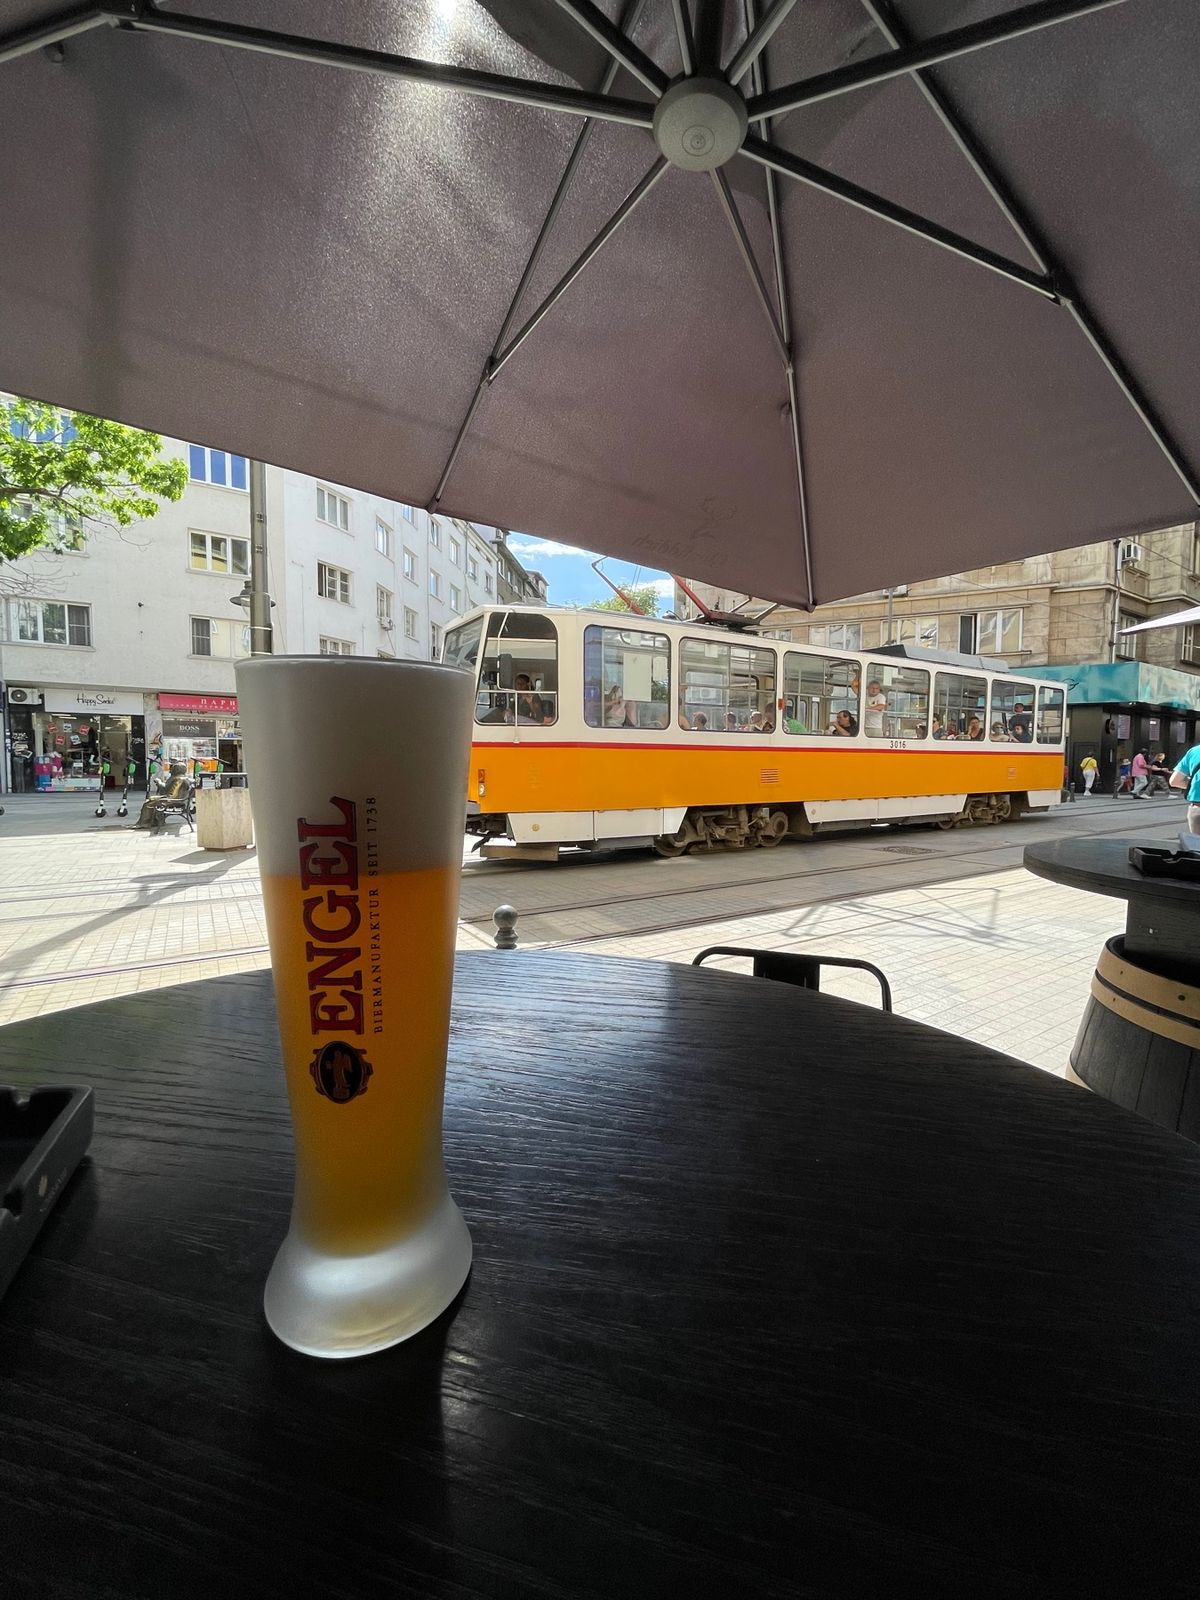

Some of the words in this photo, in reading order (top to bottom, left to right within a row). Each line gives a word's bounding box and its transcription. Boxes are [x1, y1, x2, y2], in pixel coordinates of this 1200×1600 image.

[890, 740, 906, 749] 3016
[366, 797, 378, 833] 1738
[367, 842, 379, 877] SEIT
[297, 796, 365, 1035] ENGEL
[368, 888, 383, 1034] BIERMANUFAKTUR
